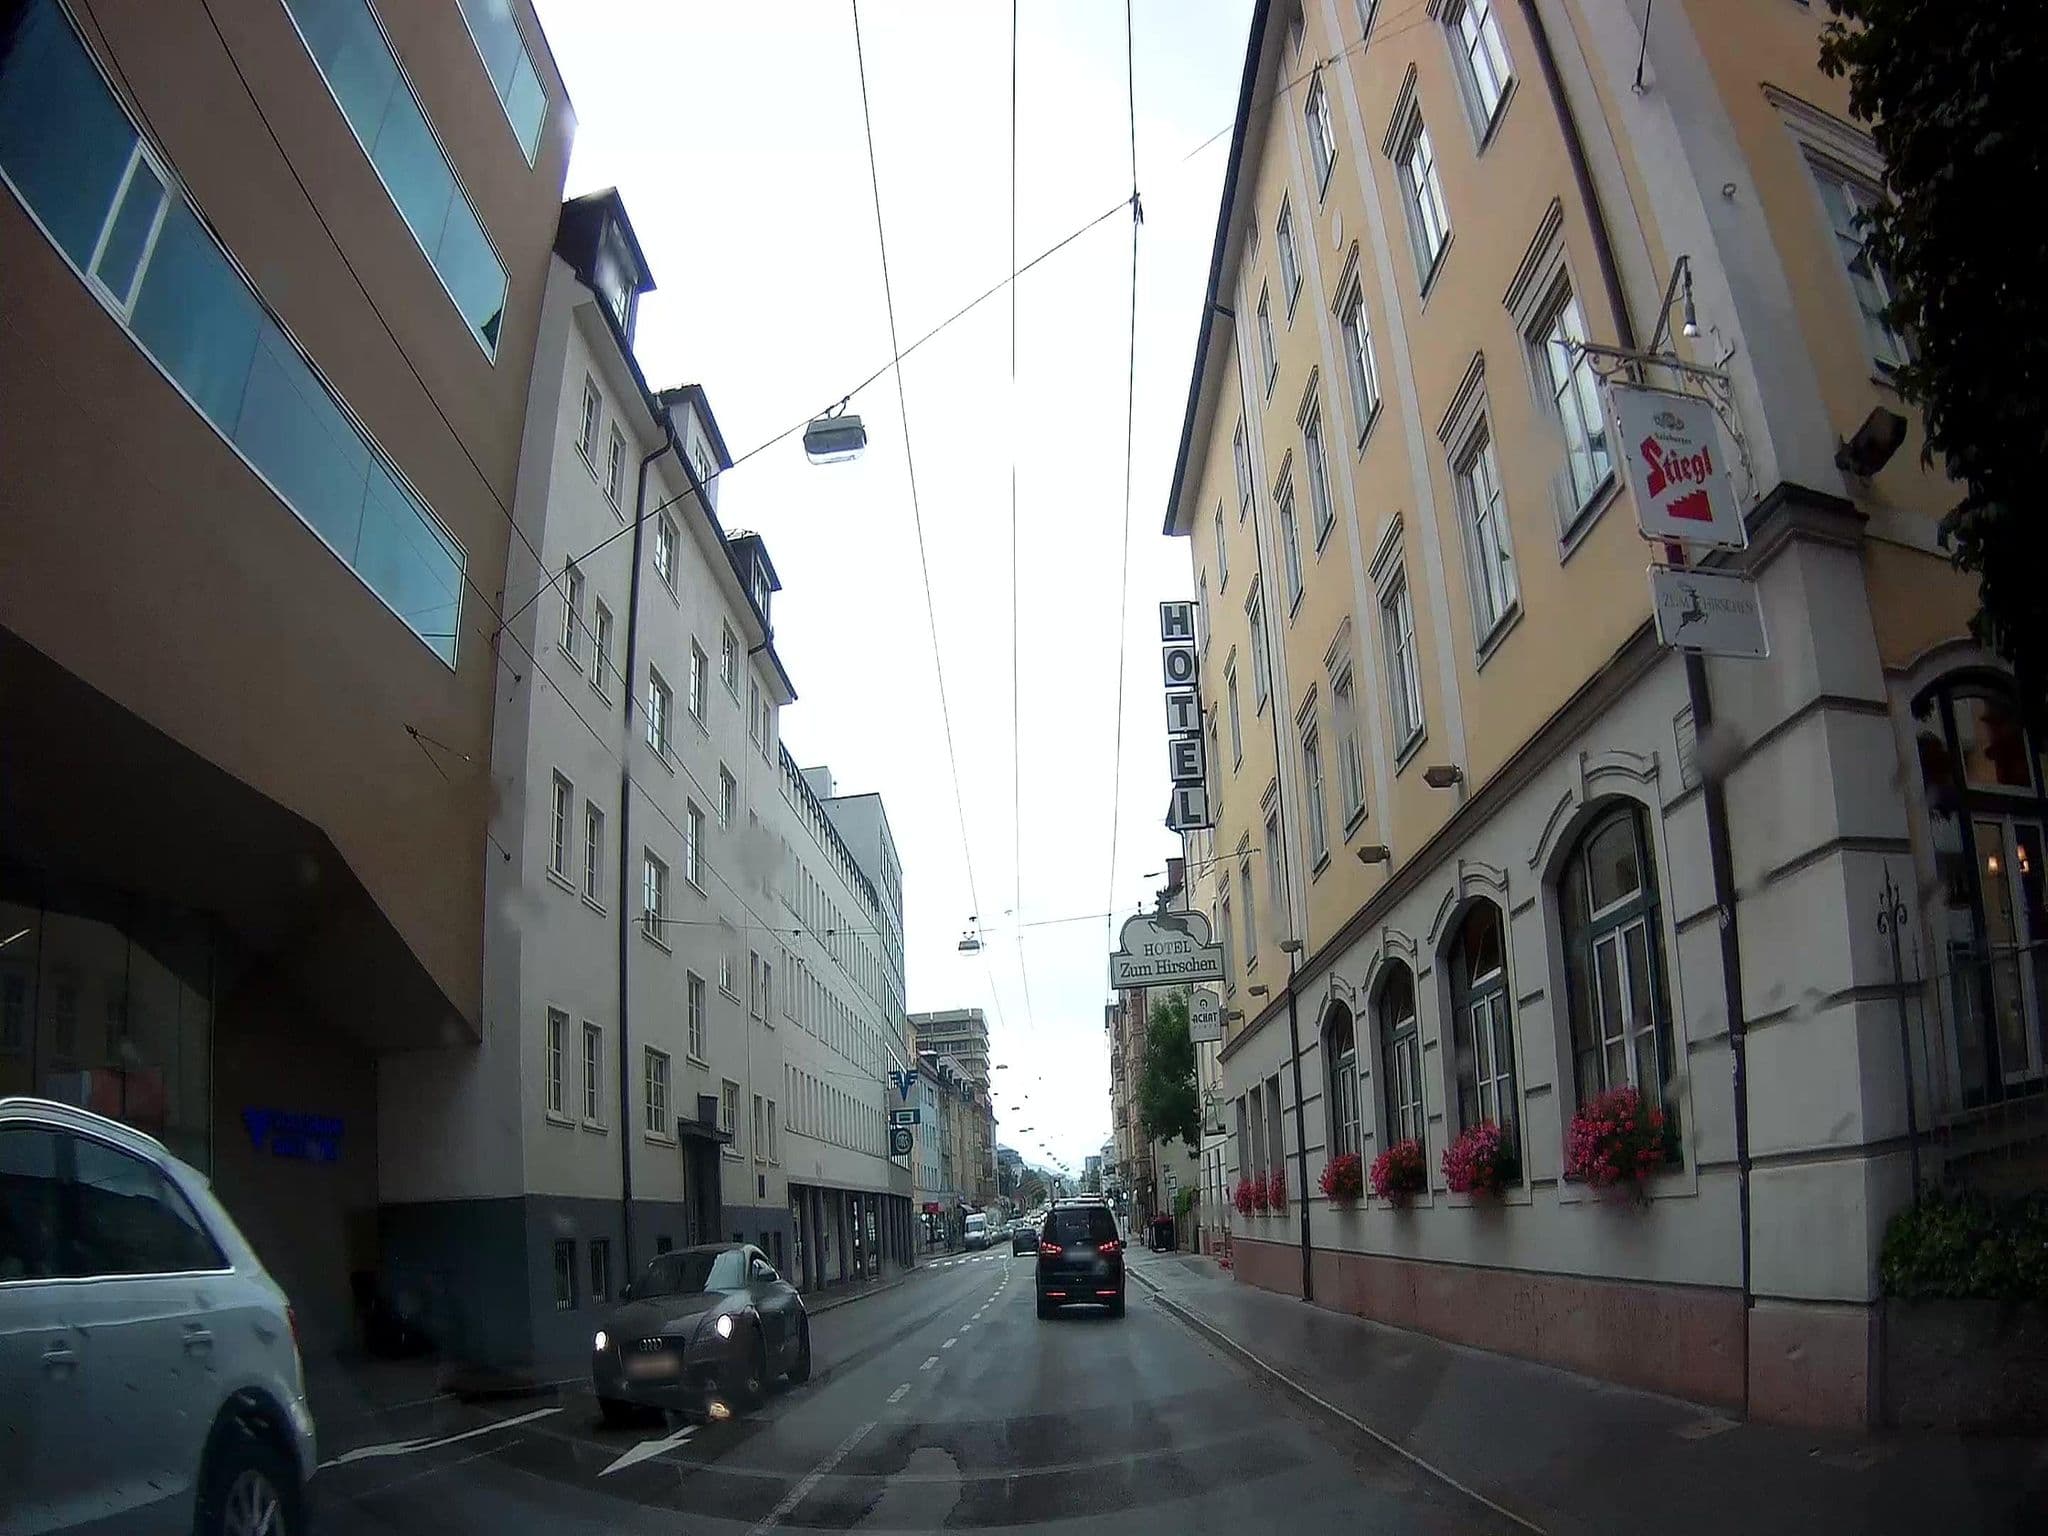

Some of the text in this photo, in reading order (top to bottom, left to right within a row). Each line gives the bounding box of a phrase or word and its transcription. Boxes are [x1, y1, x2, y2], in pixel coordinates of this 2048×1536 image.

[1640, 436, 1713, 498] Stiegl
[1163, 604, 1204, 826] HOTEL
[1144, 940, 1192, 957] HOTEL
[1120, 957, 1216, 978] Zum Hirschen
[1192, 1012, 1218, 1024] ACHAT
